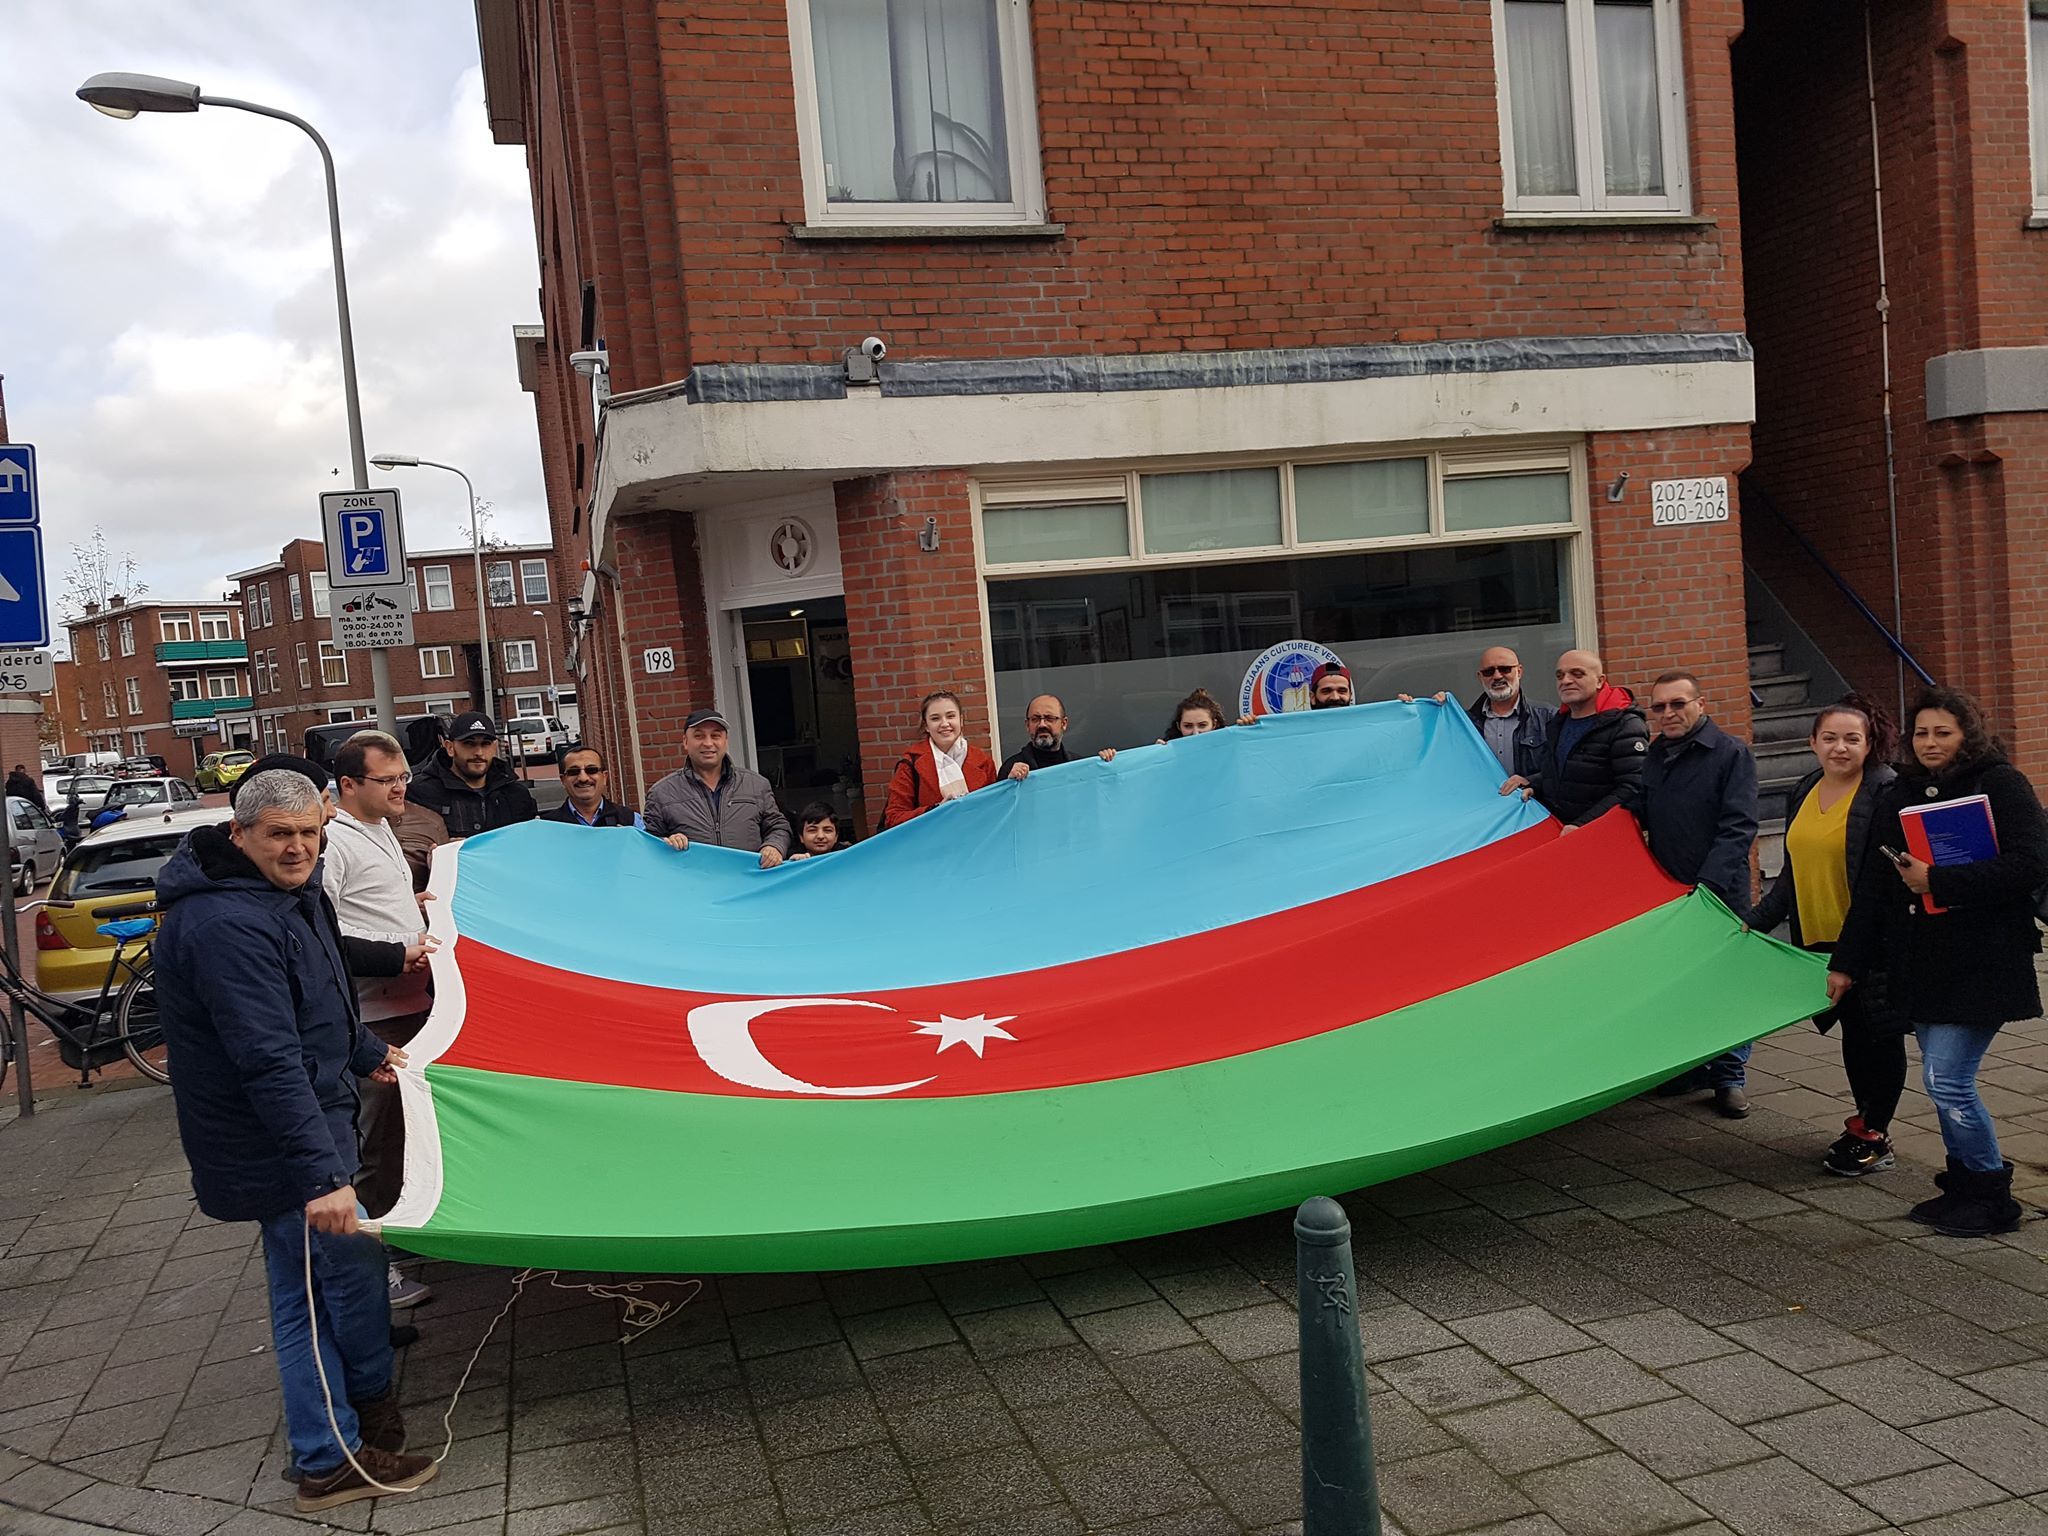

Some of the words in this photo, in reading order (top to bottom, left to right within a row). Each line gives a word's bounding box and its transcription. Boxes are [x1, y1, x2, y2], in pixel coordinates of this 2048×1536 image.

[1654, 480, 1725, 502] 202-204
[343, 497, 376, 508] ZONE
[1655, 500, 1726, 523] 200-206
[350, 516, 374, 549] P
[343, 621, 394, 631] 09.00-24.00
[345, 638, 395, 648] 18.00-24.00
[646, 650, 672, 671] 198
[1242, 654, 1270, 715] RBEIDZJAANS
[1270, 642, 1321, 657] CULTURELE
